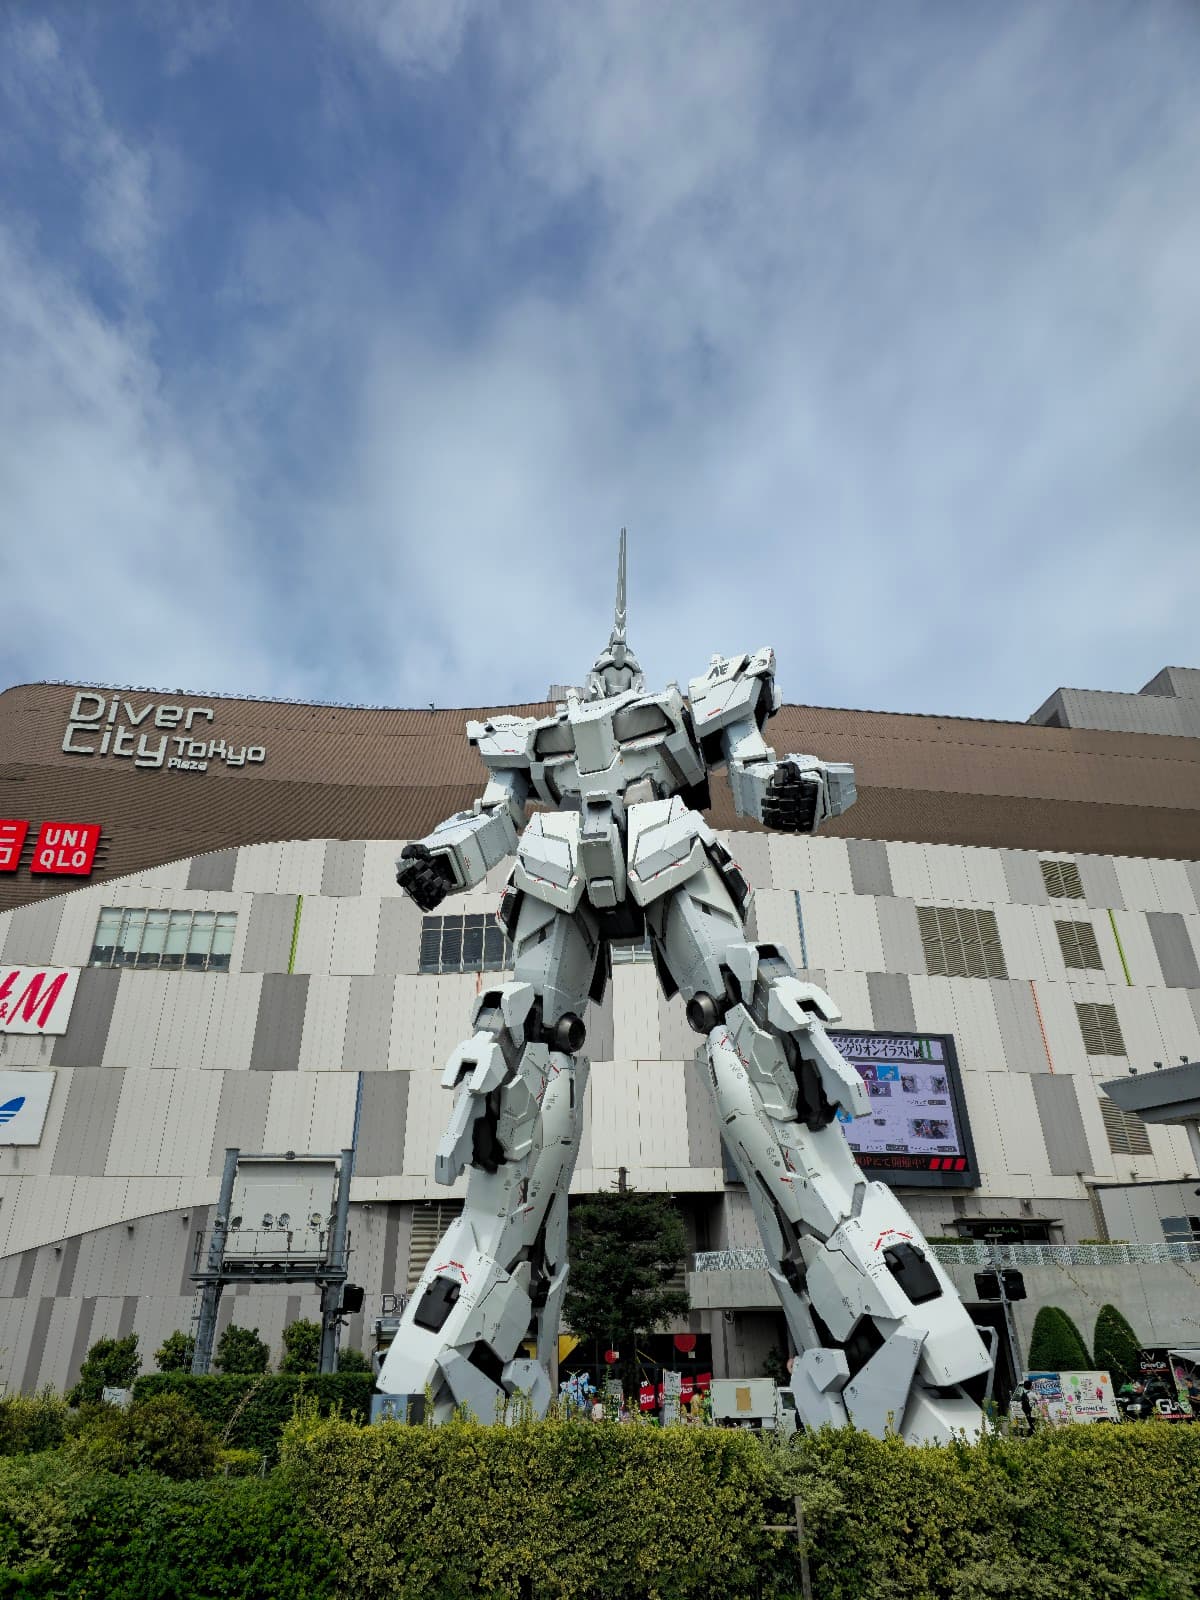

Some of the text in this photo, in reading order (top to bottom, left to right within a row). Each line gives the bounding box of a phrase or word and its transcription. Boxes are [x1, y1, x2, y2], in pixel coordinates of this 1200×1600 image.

[69, 691, 214, 729] Diver
[62, 722, 168, 768] City
[45, 828, 89, 847] UNI
[39, 849, 87, 869] QLO
